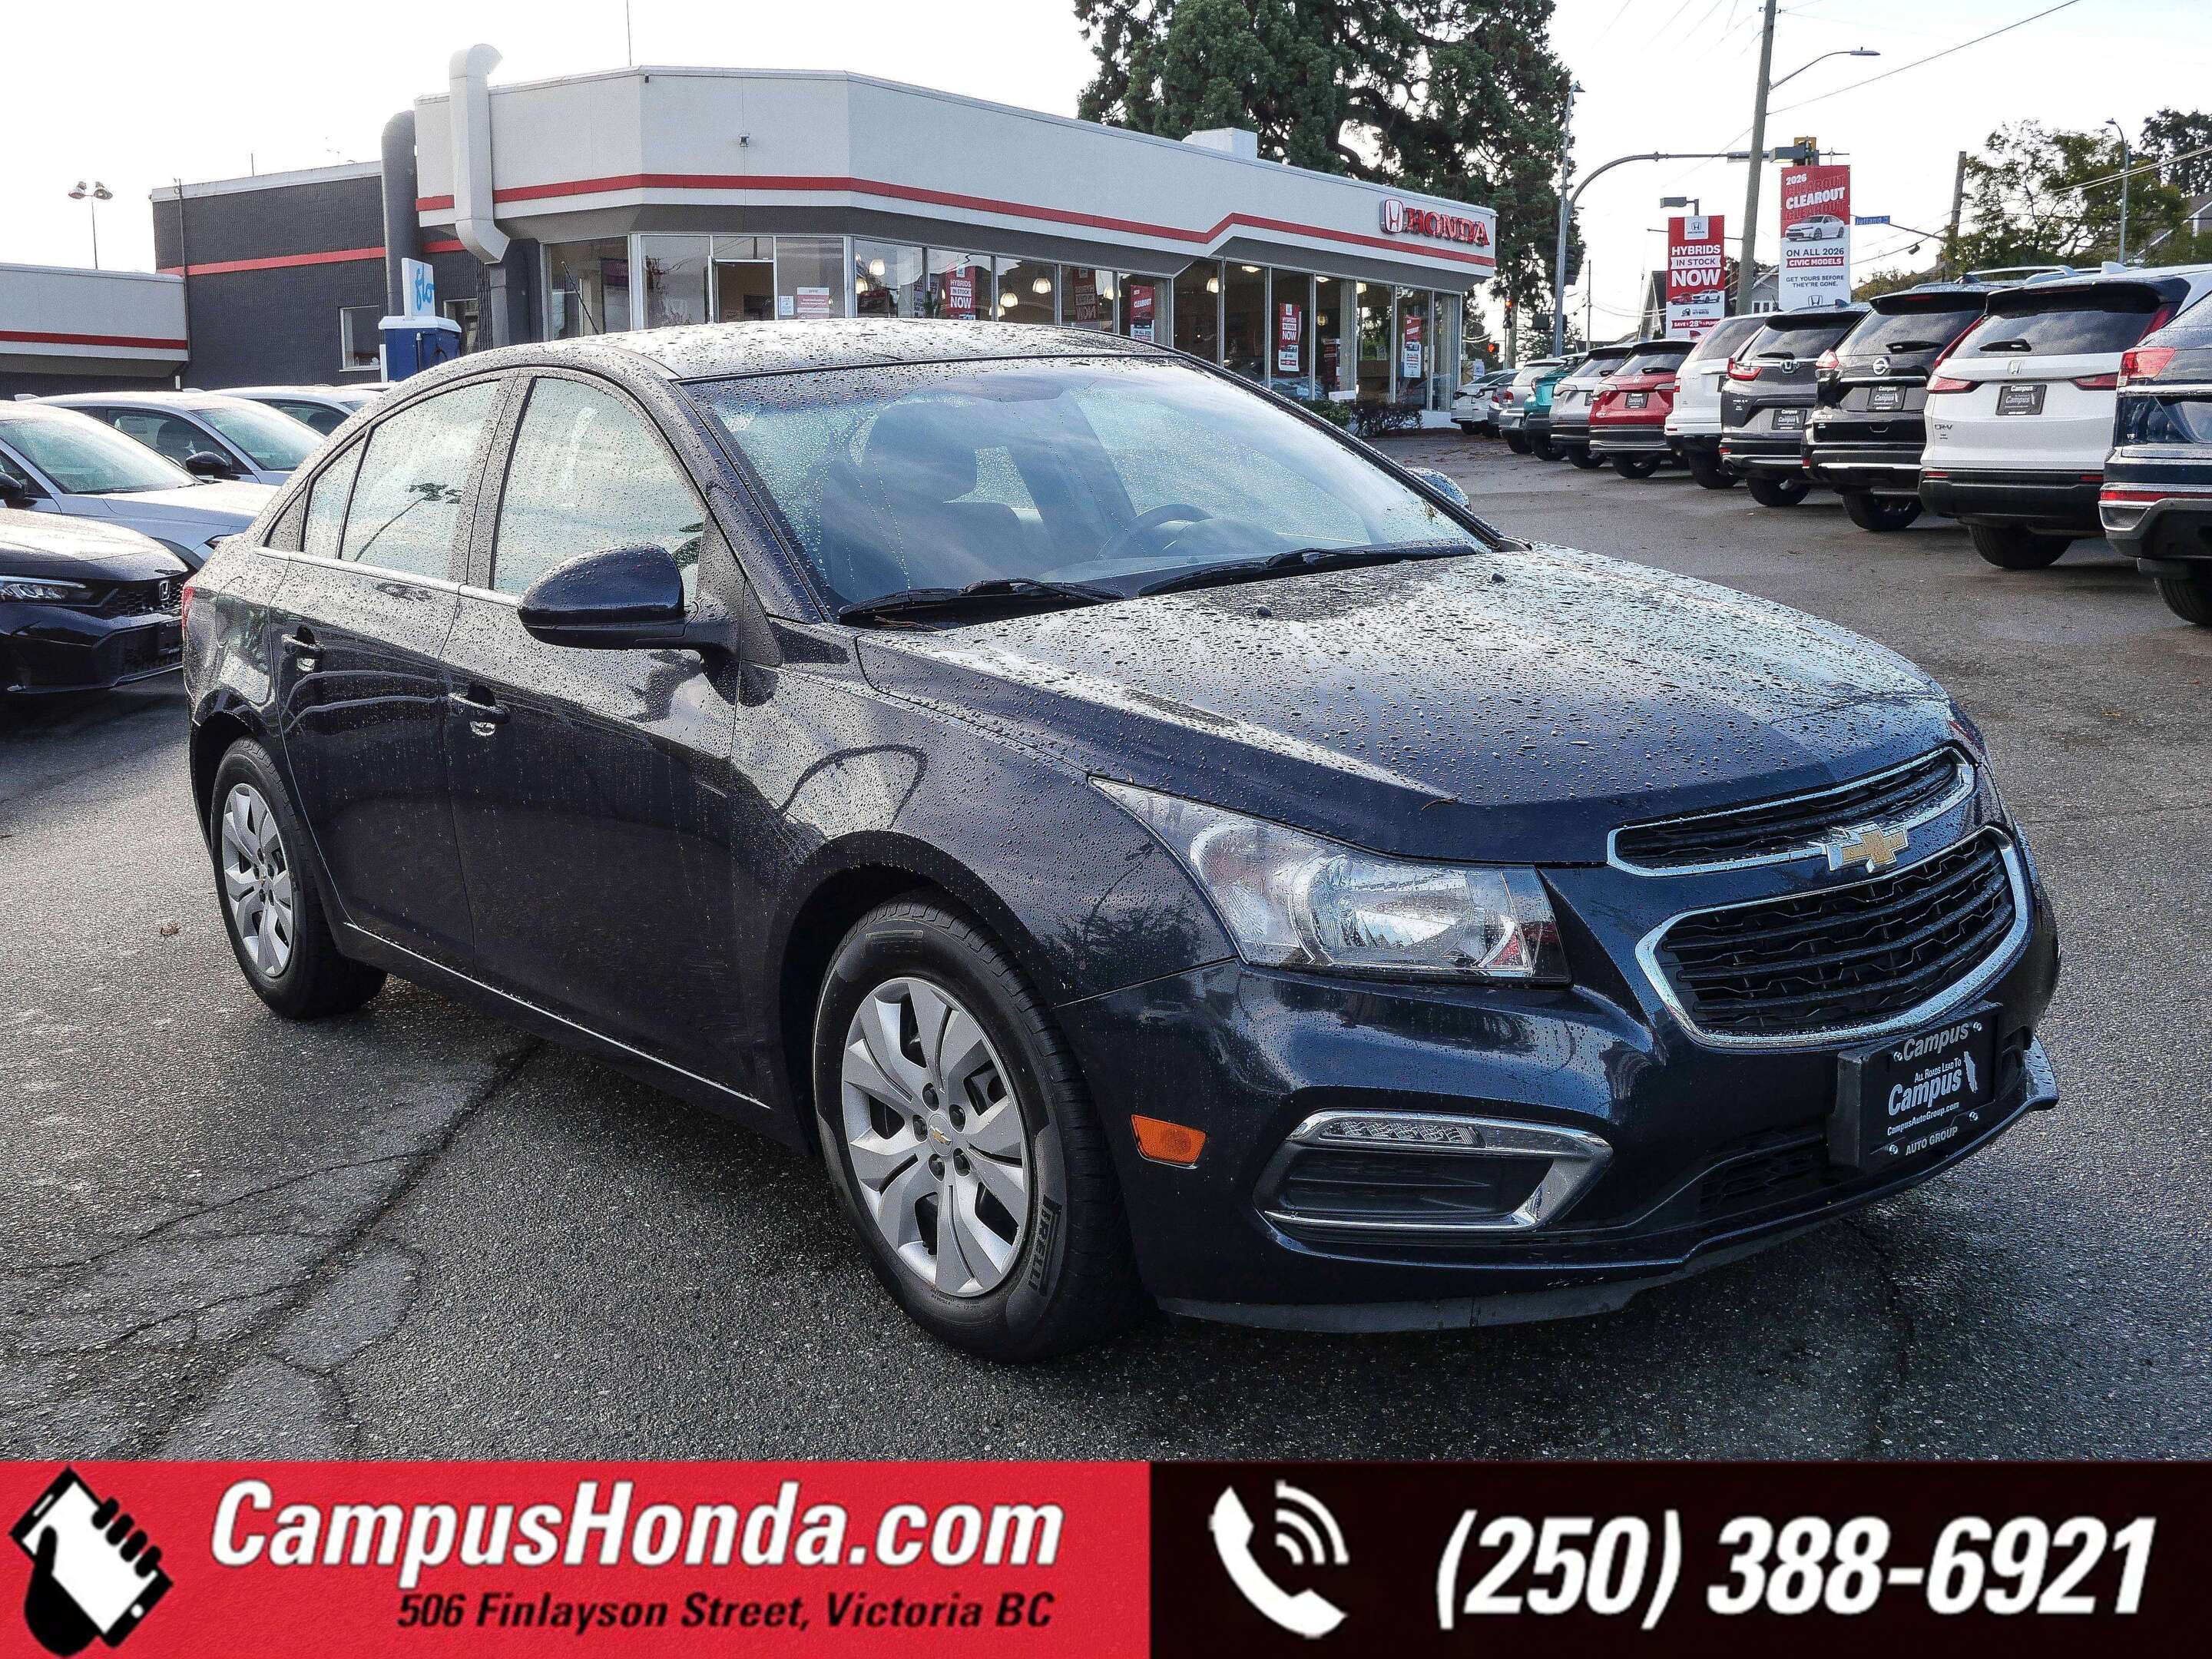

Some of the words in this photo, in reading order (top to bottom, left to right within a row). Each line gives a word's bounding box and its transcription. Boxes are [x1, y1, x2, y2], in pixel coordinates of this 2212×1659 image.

[1786, 174, 1807, 185] 2026
[1786, 187, 1846, 210] CLEAROUT
[1406, 207, 1490, 246] HONDA
[1671, 244, 1721, 256] HYBRIDS
[1823, 247, 1844, 256] 2026
[1811, 257, 1841, 266] MODELS
[1671, 269, 1721, 287] NOW
[950, 296, 972, 309] NOW
[1282, 331, 1296, 340] NOW
[1903, 1022, 1969, 1061] Campus
[1889, 1068, 1962, 1116] Campus
[1887, 1101, 1959, 1136] CampusAutoGroup.com
[1906, 1138, 1928, 1156] AUTO
[1929, 1126, 1959, 1145] GROUP
